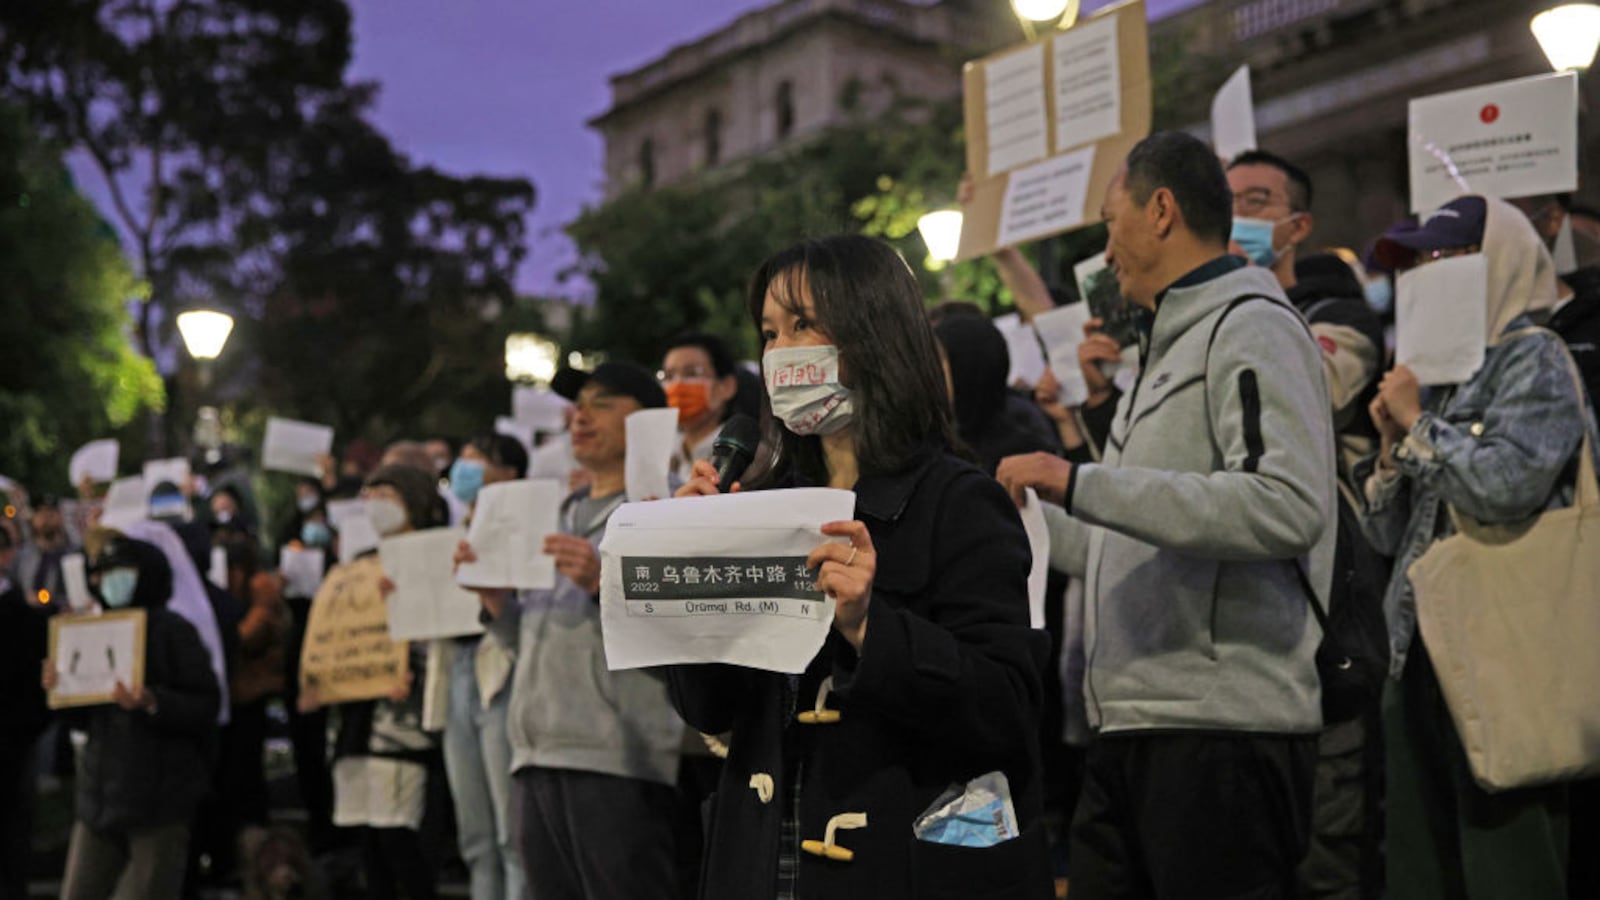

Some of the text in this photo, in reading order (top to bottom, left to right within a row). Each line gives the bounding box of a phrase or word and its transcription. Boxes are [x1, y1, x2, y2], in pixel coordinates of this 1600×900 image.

[635, 565, 810, 585] 南 乌鲁木齐中路 北
[631, 582, 660, 593] 2022
[644, 603, 654, 614] S
[735, 602, 754, 612] Rd.
[759, 602, 779, 614] (M)
[801, 604, 810, 616] N
